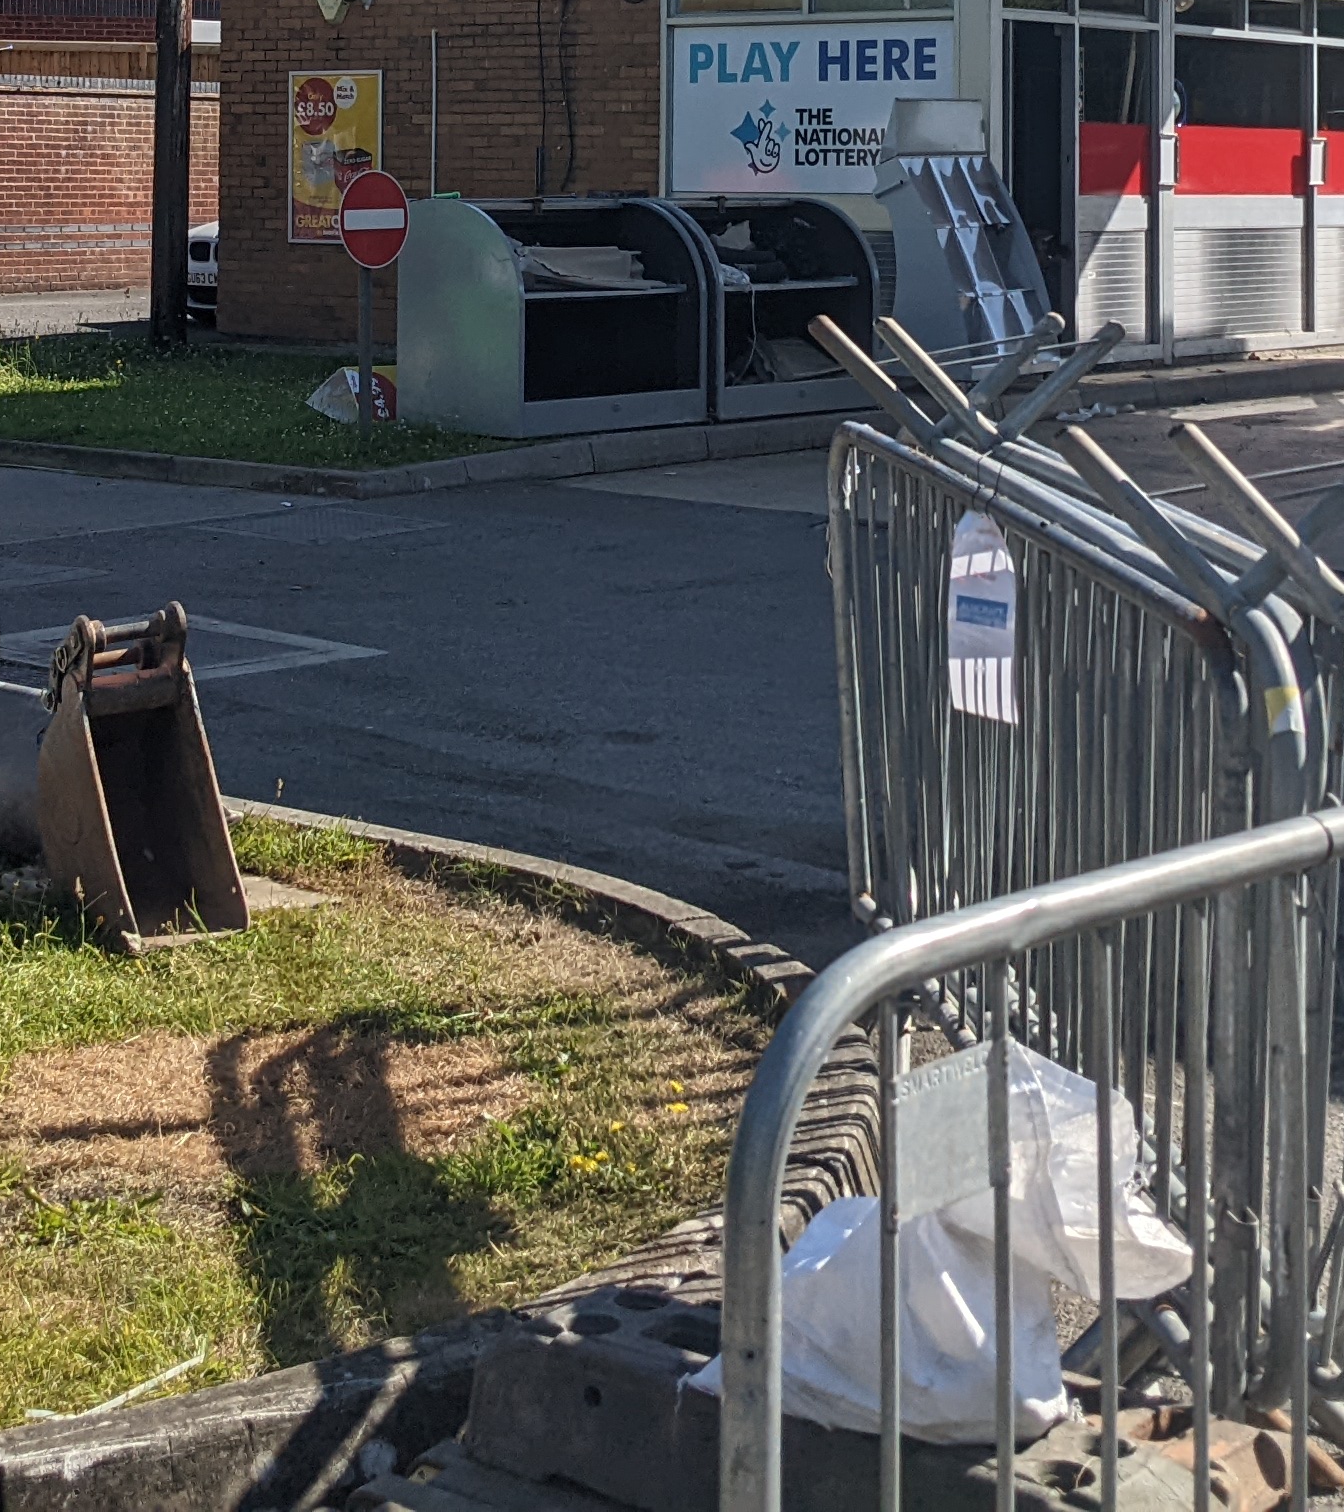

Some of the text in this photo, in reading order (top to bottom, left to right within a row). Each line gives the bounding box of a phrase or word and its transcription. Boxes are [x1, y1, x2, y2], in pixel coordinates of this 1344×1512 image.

[688, 38, 937, 84] PLAY HERE
[297, 101, 335, 117] £8.50
[794, 108, 833, 126] THE
[794, 148, 880, 166] LOTTERY
